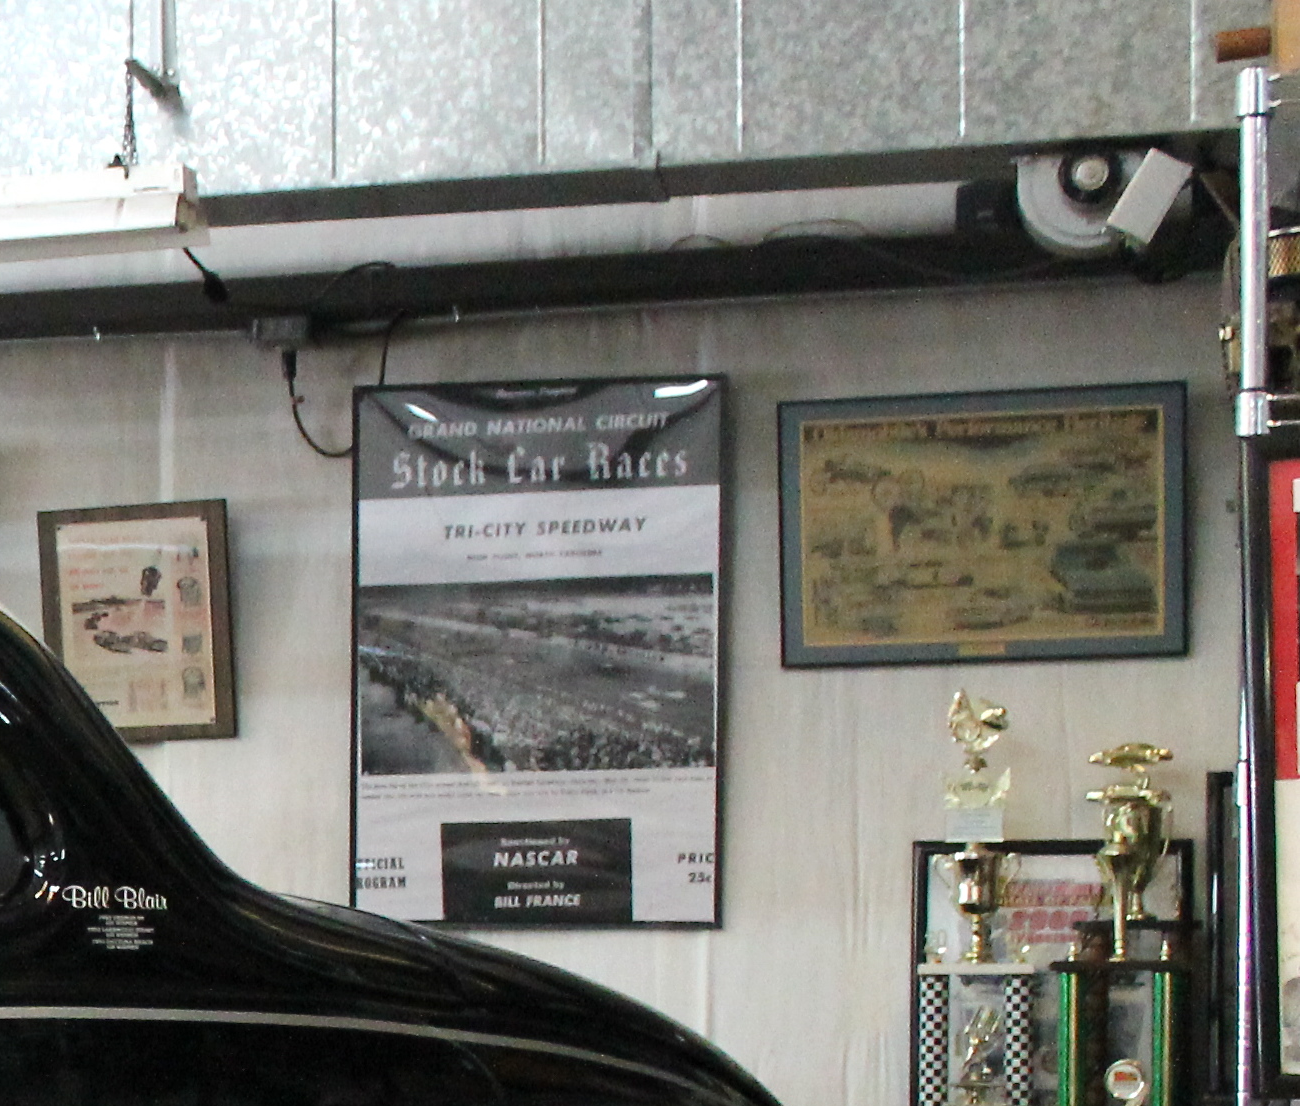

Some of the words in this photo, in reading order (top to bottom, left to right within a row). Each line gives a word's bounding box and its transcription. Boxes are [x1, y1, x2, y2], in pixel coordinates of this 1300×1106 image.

[408, 420, 478, 439] GRAND
[486, 416, 587, 436] NATIONAL
[595, 410, 670, 430] CIRCUIT
[391, 450, 486, 490] Stock
[506, 446, 567, 485] Car
[587, 441, 689, 481] Races
[443, 520, 528, 540] TRI-CITY
[536, 516, 648, 537] SPEEDWAY
[492, 849, 580, 869] NASCAR
[354, 876, 407, 890] ROGRAM
[61, 884, 111, 910] Bill
[114, 885, 168, 911] Blair
[493, 895, 523, 909] BILL
[525, 893, 583, 909] FRANCE
